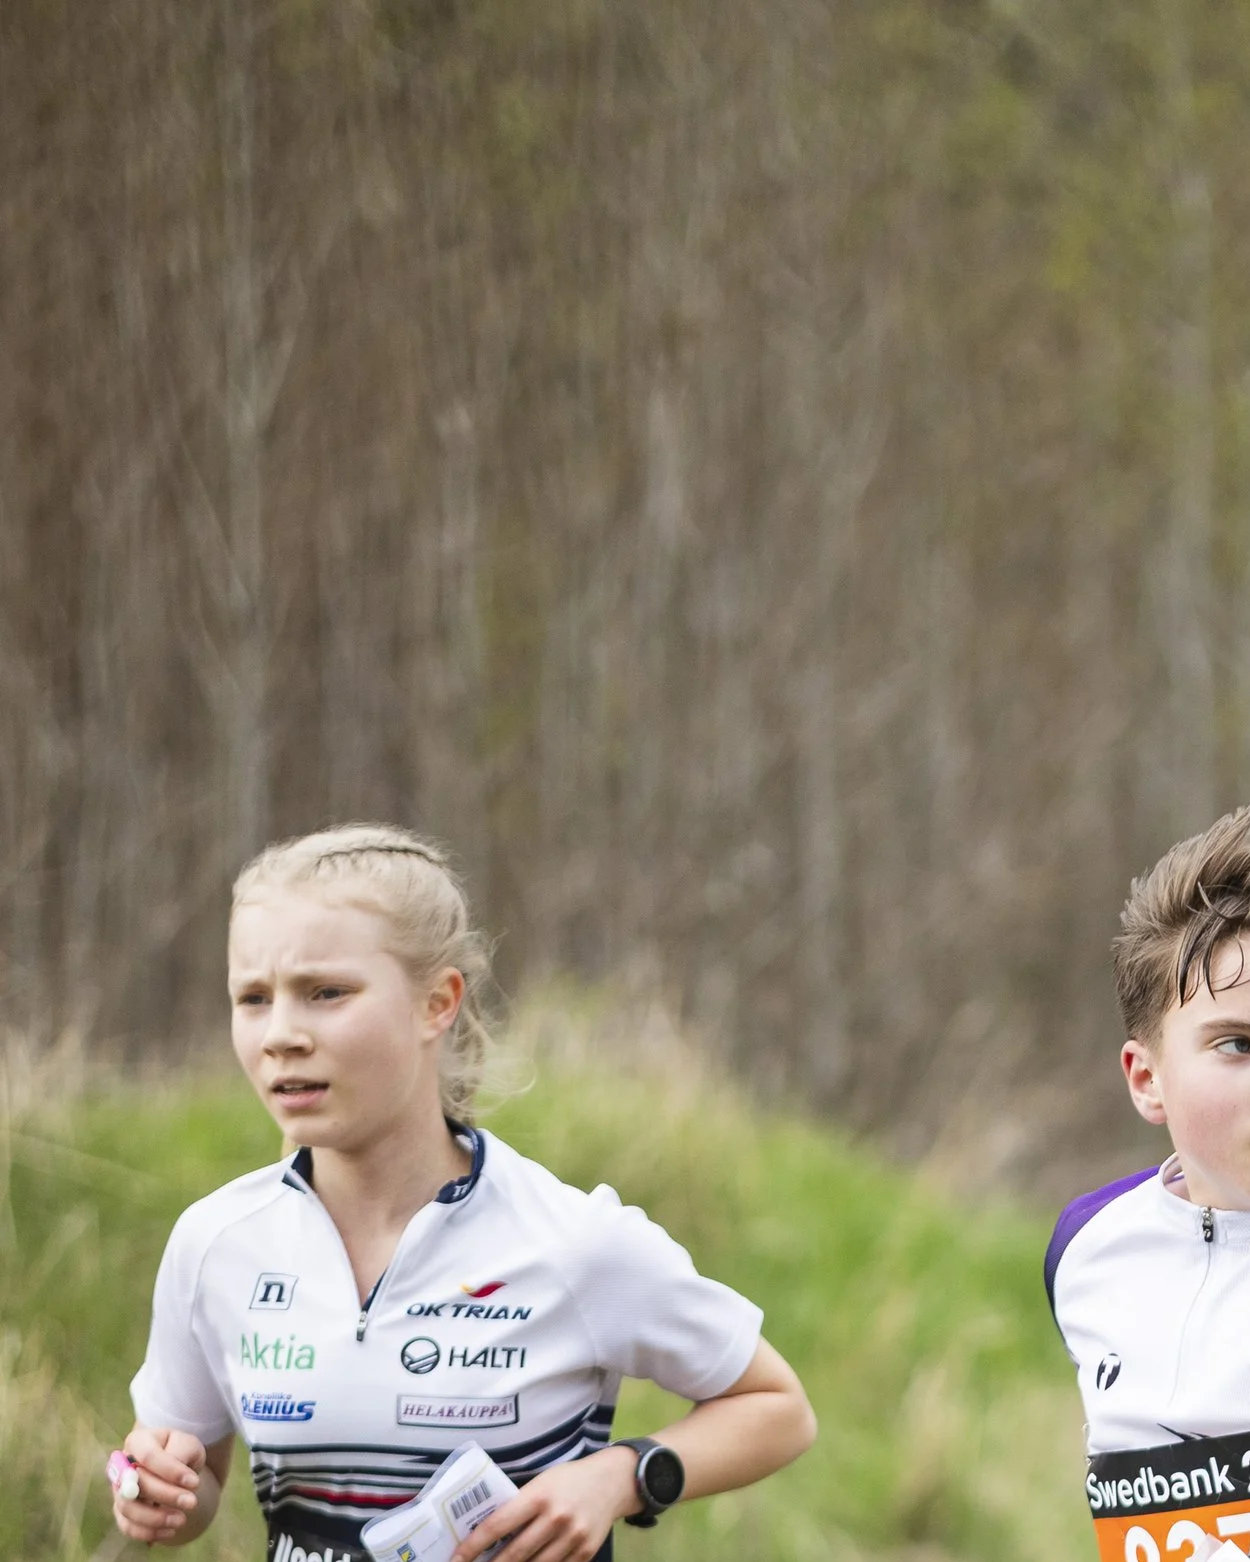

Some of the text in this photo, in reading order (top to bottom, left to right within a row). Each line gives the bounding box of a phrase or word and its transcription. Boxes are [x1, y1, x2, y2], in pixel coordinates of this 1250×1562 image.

[406, 1302, 533, 1320] OK TRIAN
[241, 1332, 316, 1369] Aktia
[448, 1346, 527, 1368] HALTI
[1086, 1456, 1236, 1509] Swedbank
